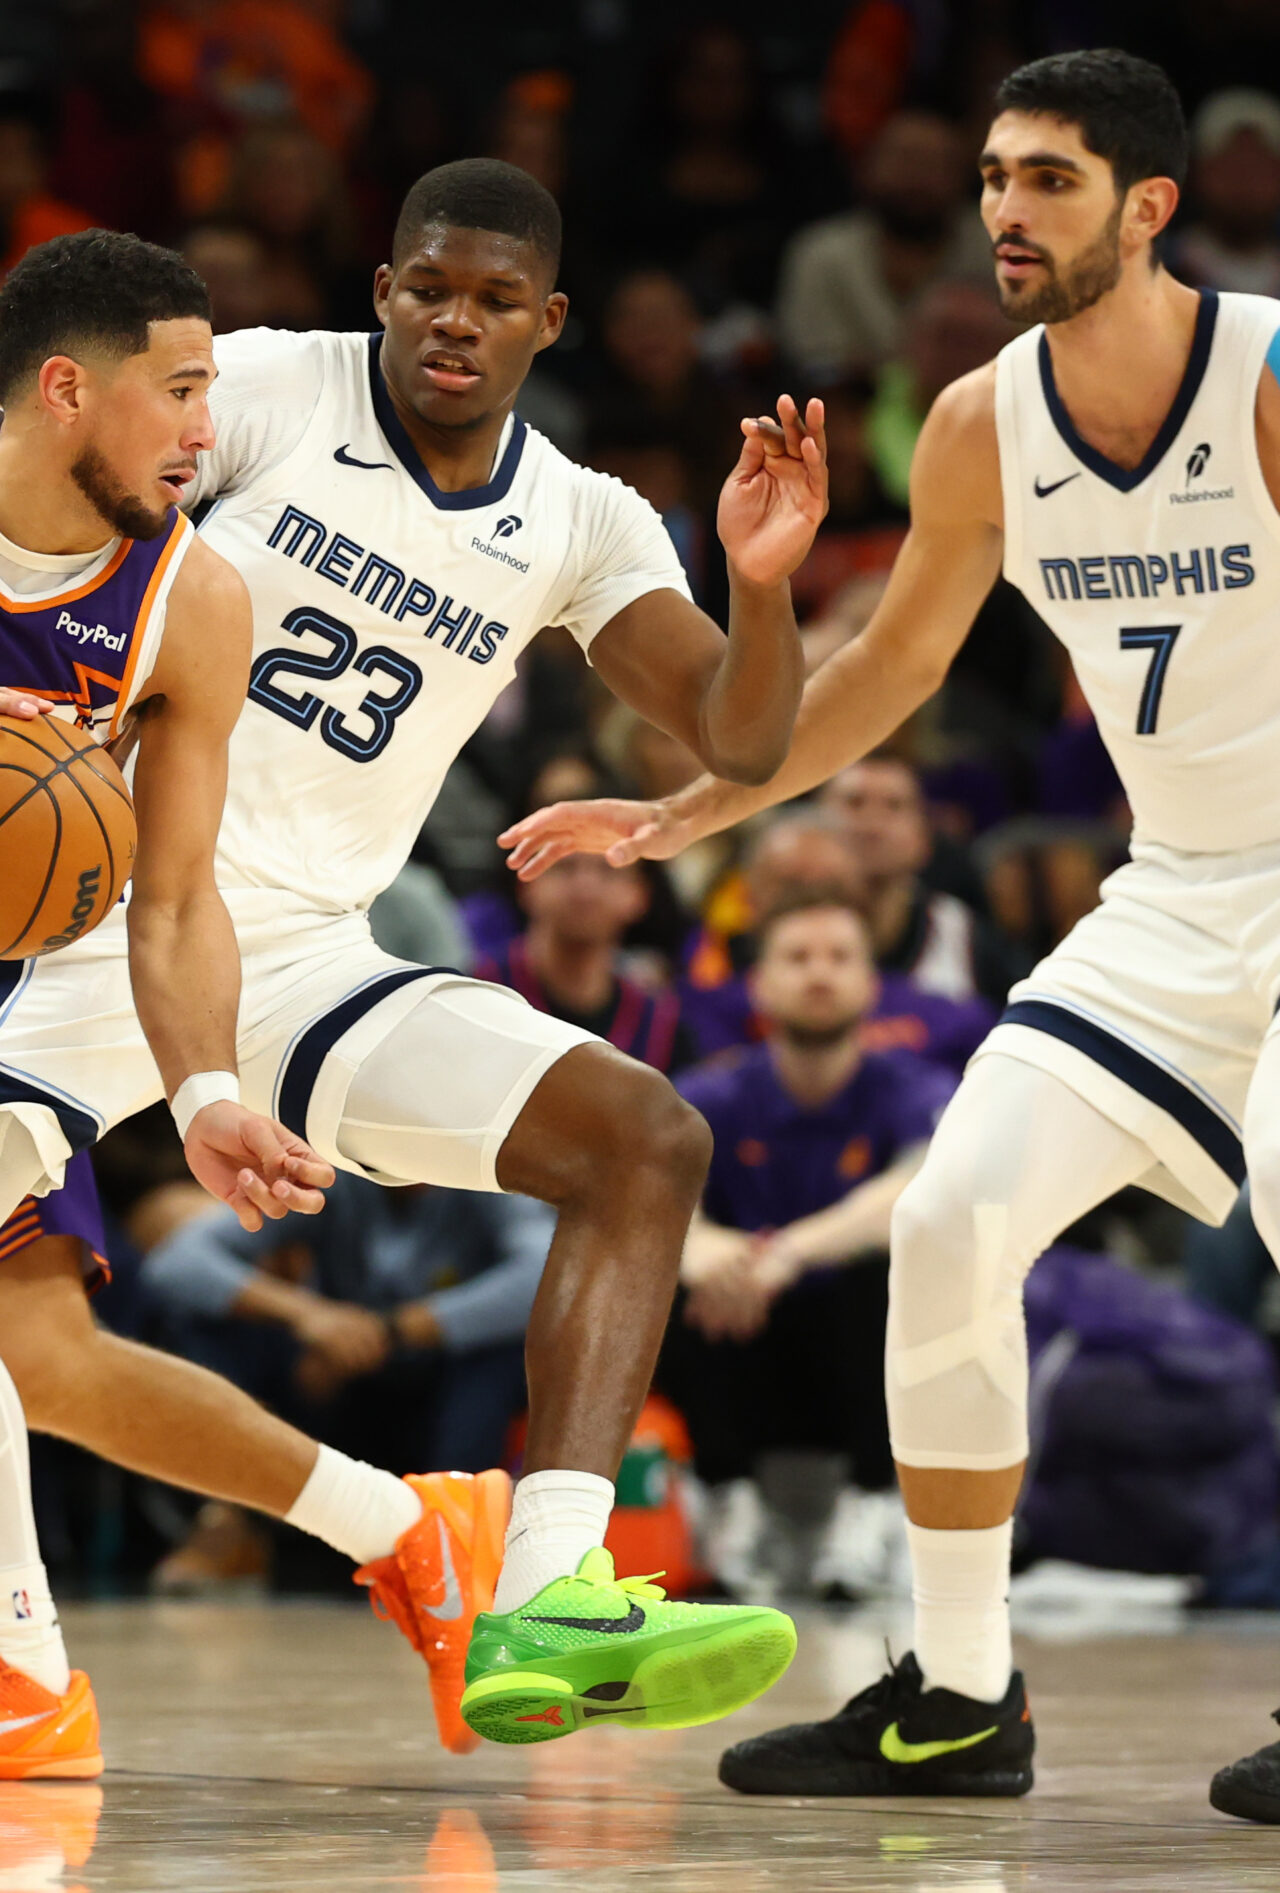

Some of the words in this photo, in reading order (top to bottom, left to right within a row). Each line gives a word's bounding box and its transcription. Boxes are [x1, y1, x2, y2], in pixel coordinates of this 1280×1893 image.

[1169, 486, 1234, 506] Robinhood
[471, 536, 530, 574] Robinhood
[1039, 544, 1256, 600] MEMPHIS
[266, 504, 510, 665] MEMPHIS
[55, 610, 127, 652] PayPal
[247, 606, 423, 764] 23
[1119, 624, 1183, 735] 7
